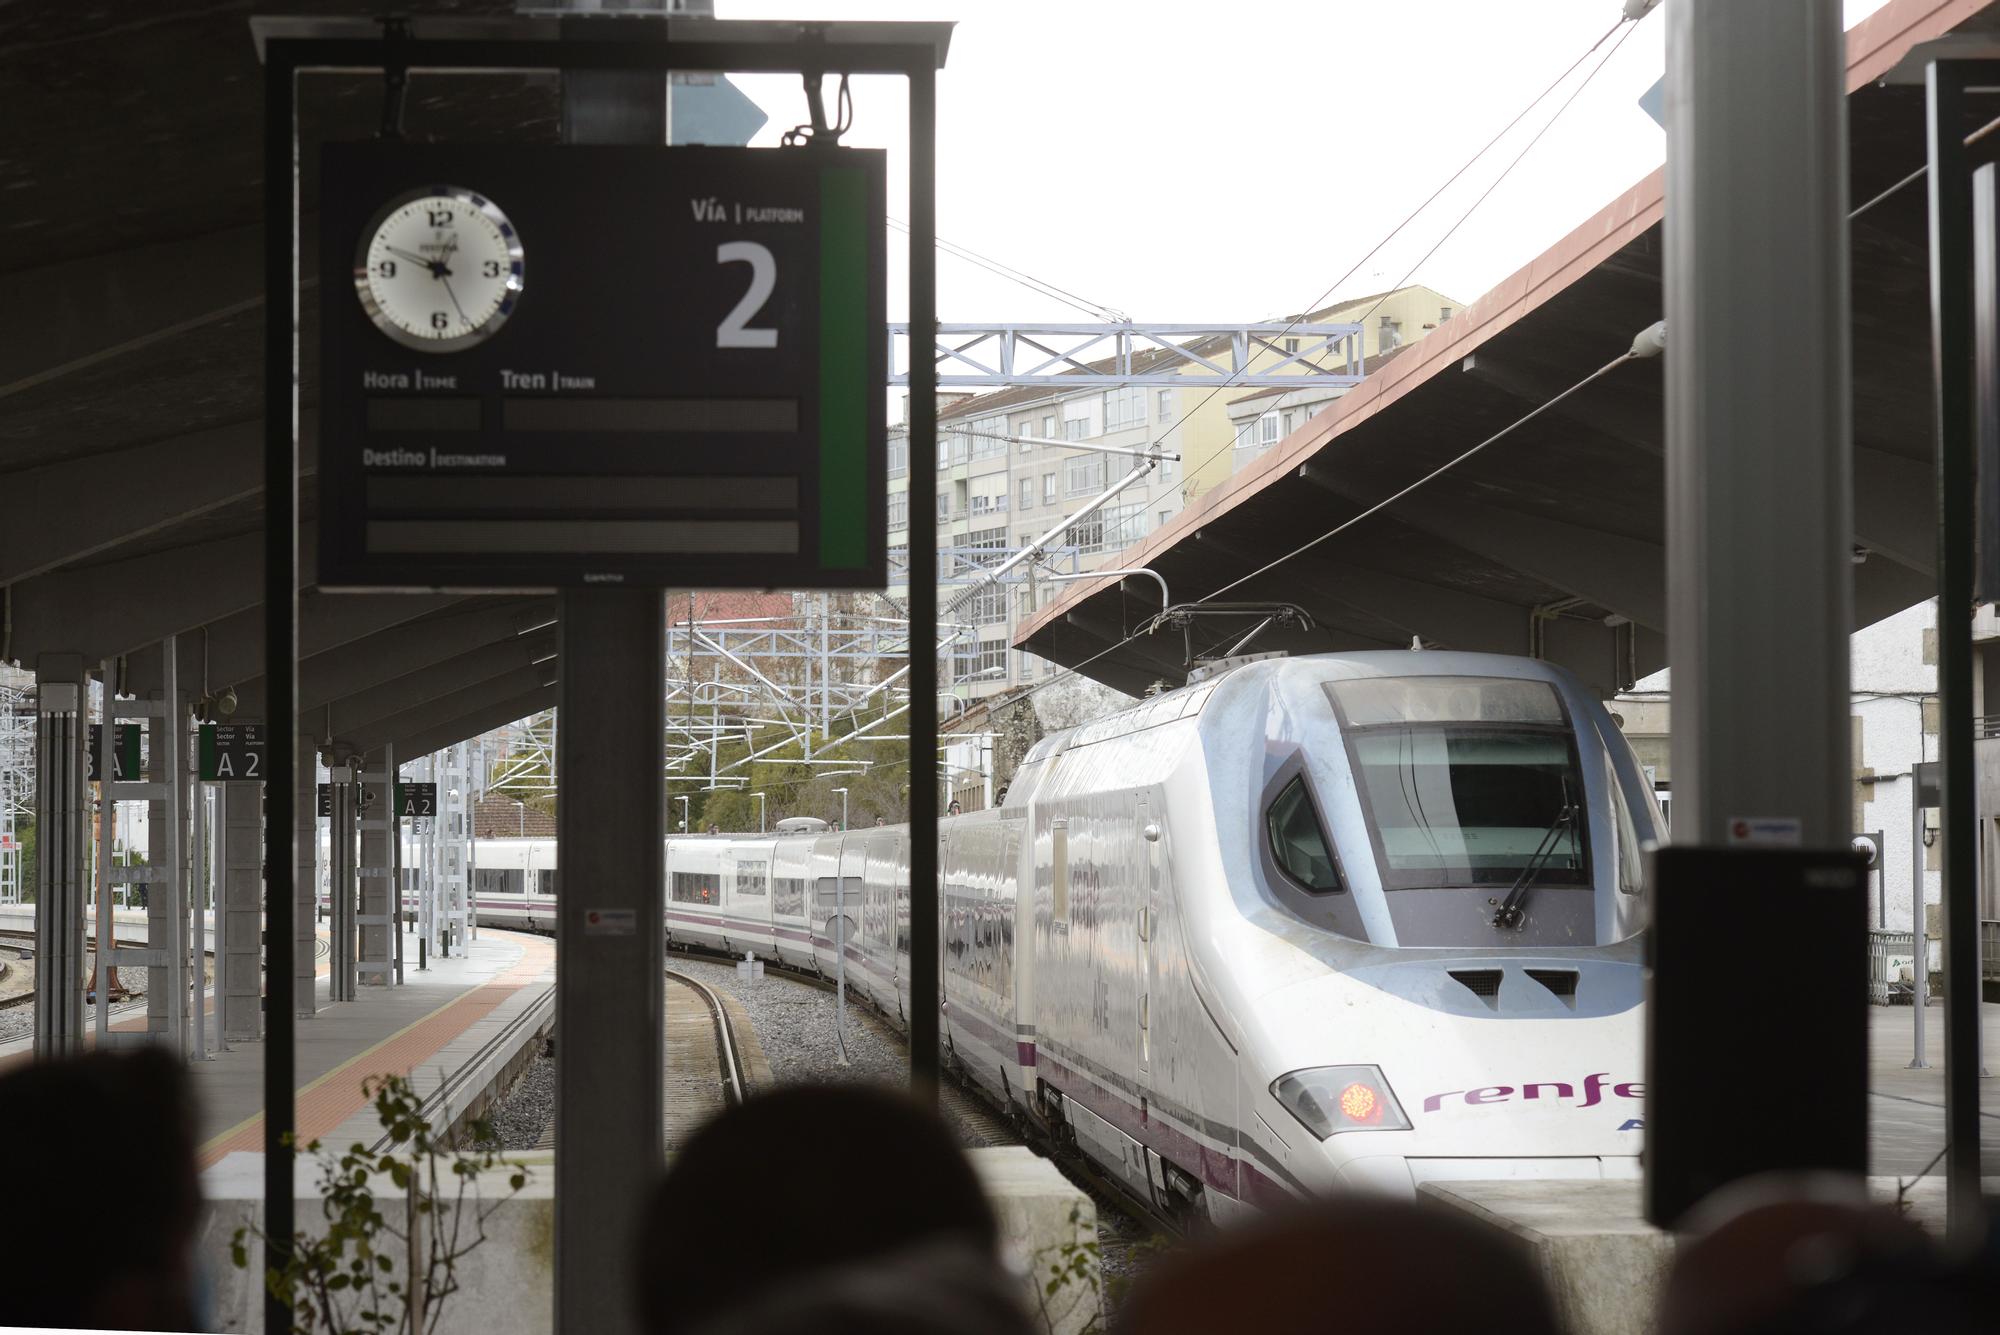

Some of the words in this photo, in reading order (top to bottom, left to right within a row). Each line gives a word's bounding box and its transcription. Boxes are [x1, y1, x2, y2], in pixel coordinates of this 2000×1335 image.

[427, 211, 454, 228] 12
[746, 208, 804, 223] PLATFORM
[380, 261, 396, 278] 9
[482, 261, 499, 278] 3
[716, 241, 778, 348] 2
[431, 313, 448, 329] 6
[363, 371, 409, 389] Hora
[423, 376, 457, 389] TIME
[500, 370, 546, 389] Tren
[362, 448, 426, 467] Destino
[216, 752, 235, 777] A
[245, 753, 259, 777] 2
[405, 800, 416, 815] A
[422, 800, 431, 815] 2
[1423, 1072, 1646, 1113] renfe
[1617, 1118, 1646, 1131] A
